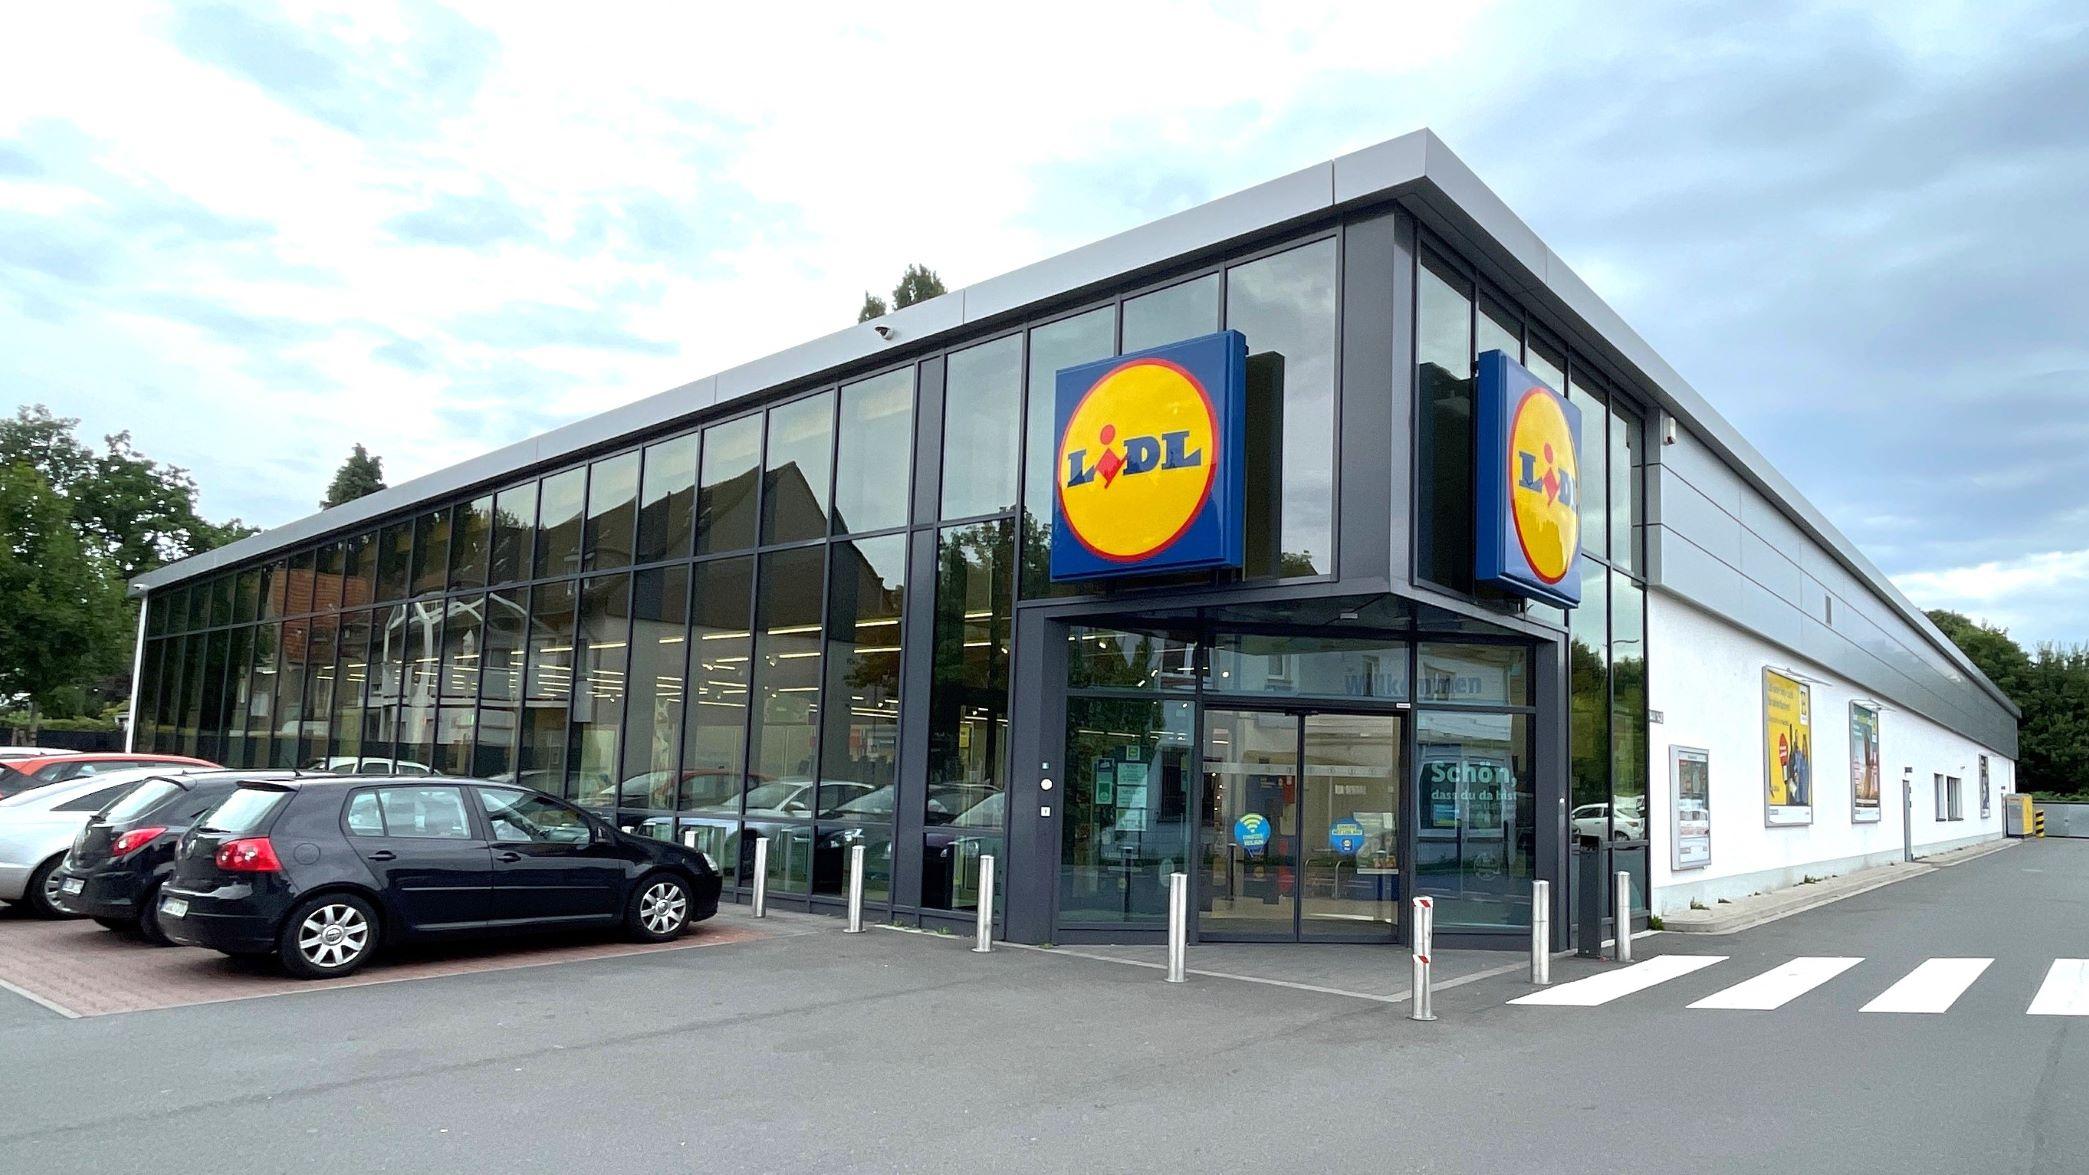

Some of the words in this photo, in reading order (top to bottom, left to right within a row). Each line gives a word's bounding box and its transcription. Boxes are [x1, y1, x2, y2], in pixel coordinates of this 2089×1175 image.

[1431, 760, 1517, 787] Schön,
[1460, 789, 1476, 800] du
[1479, 789, 1493, 800] da
